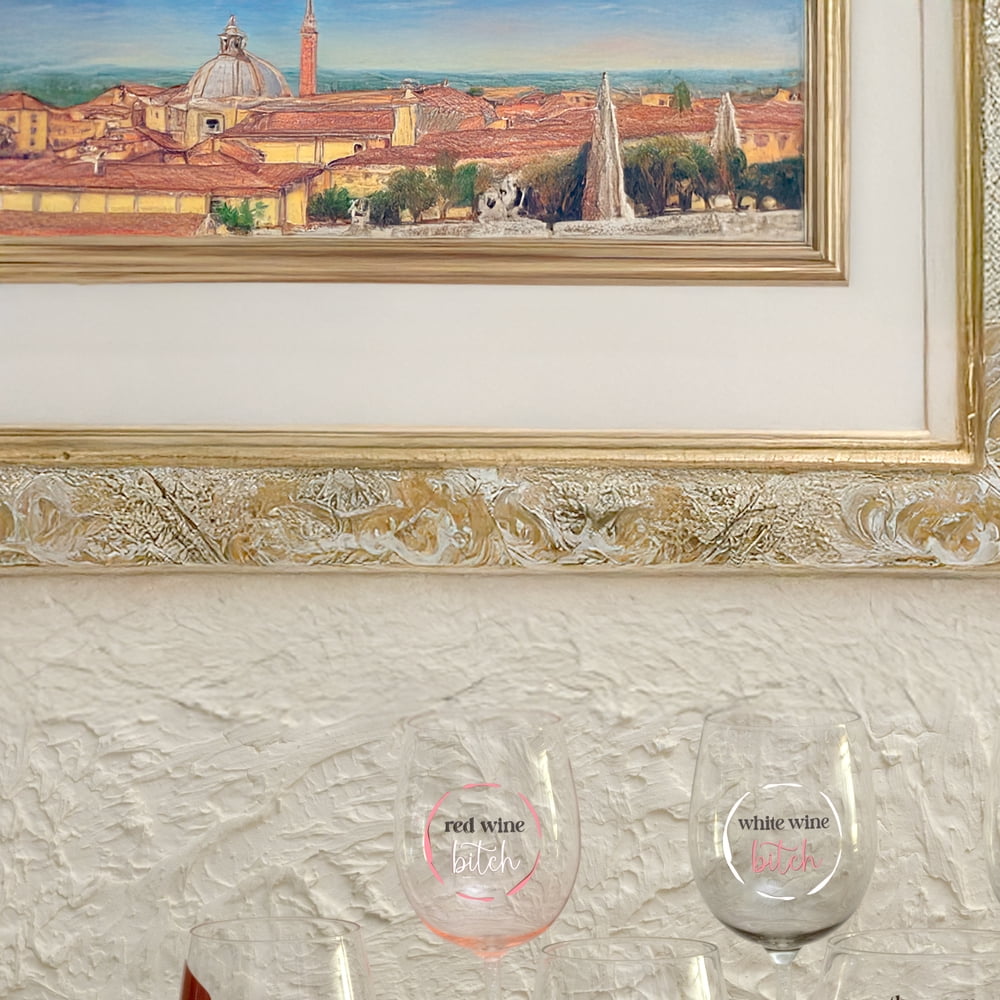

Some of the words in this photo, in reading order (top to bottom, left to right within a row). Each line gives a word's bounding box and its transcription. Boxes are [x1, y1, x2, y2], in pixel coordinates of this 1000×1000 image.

[445, 816, 475, 833] red
[480, 817, 525, 833] wine
[738, 815, 785, 830] white
[788, 815, 830, 830] wine
[452, 839, 521, 875] bitch
[751, 838, 823, 875] bitch
